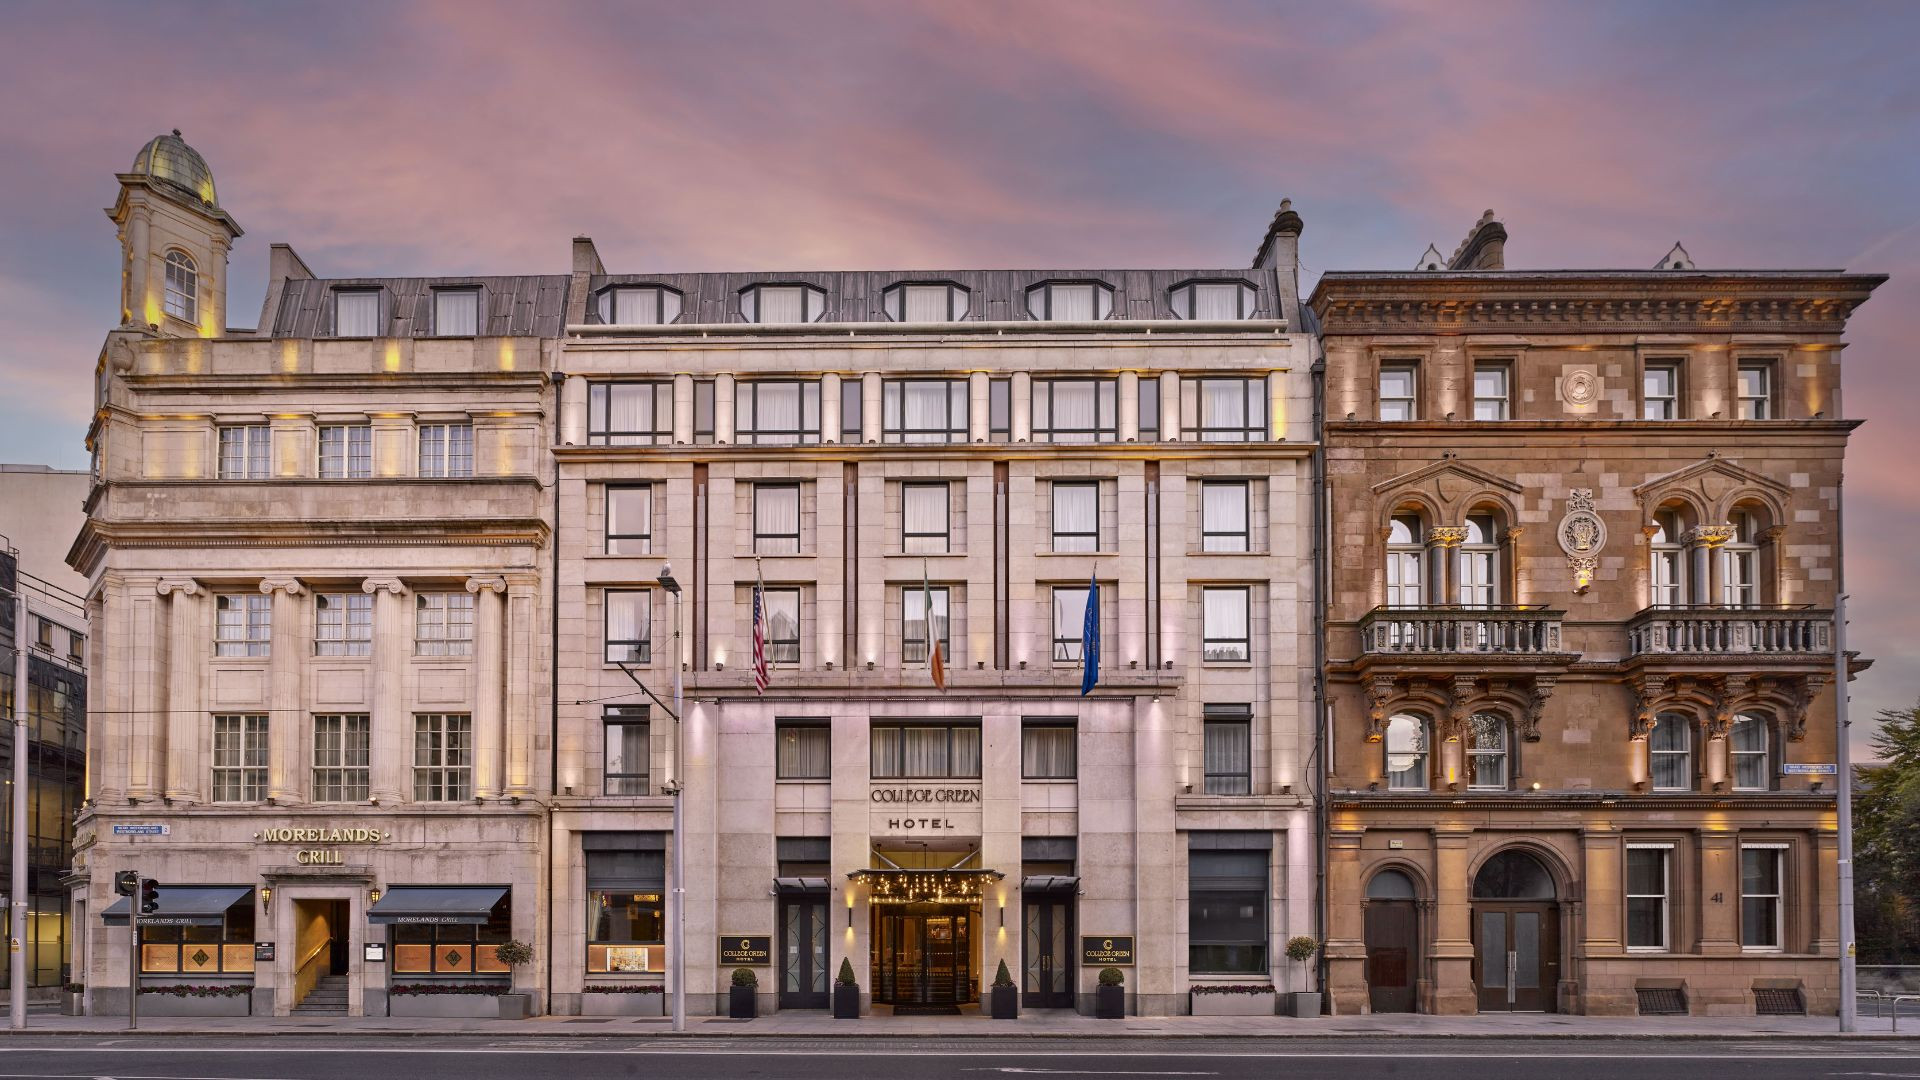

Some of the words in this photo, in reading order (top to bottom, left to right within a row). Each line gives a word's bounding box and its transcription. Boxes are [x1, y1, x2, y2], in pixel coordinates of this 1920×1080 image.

[872, 789, 933, 803] COLLEGE
[935, 789, 980, 803] GREEN
[888, 818, 955, 829] HOTEL
[263, 828, 381, 842] MORELANDS
[296, 850, 343, 864] GRILL
[1710, 892, 1723, 904] 41
